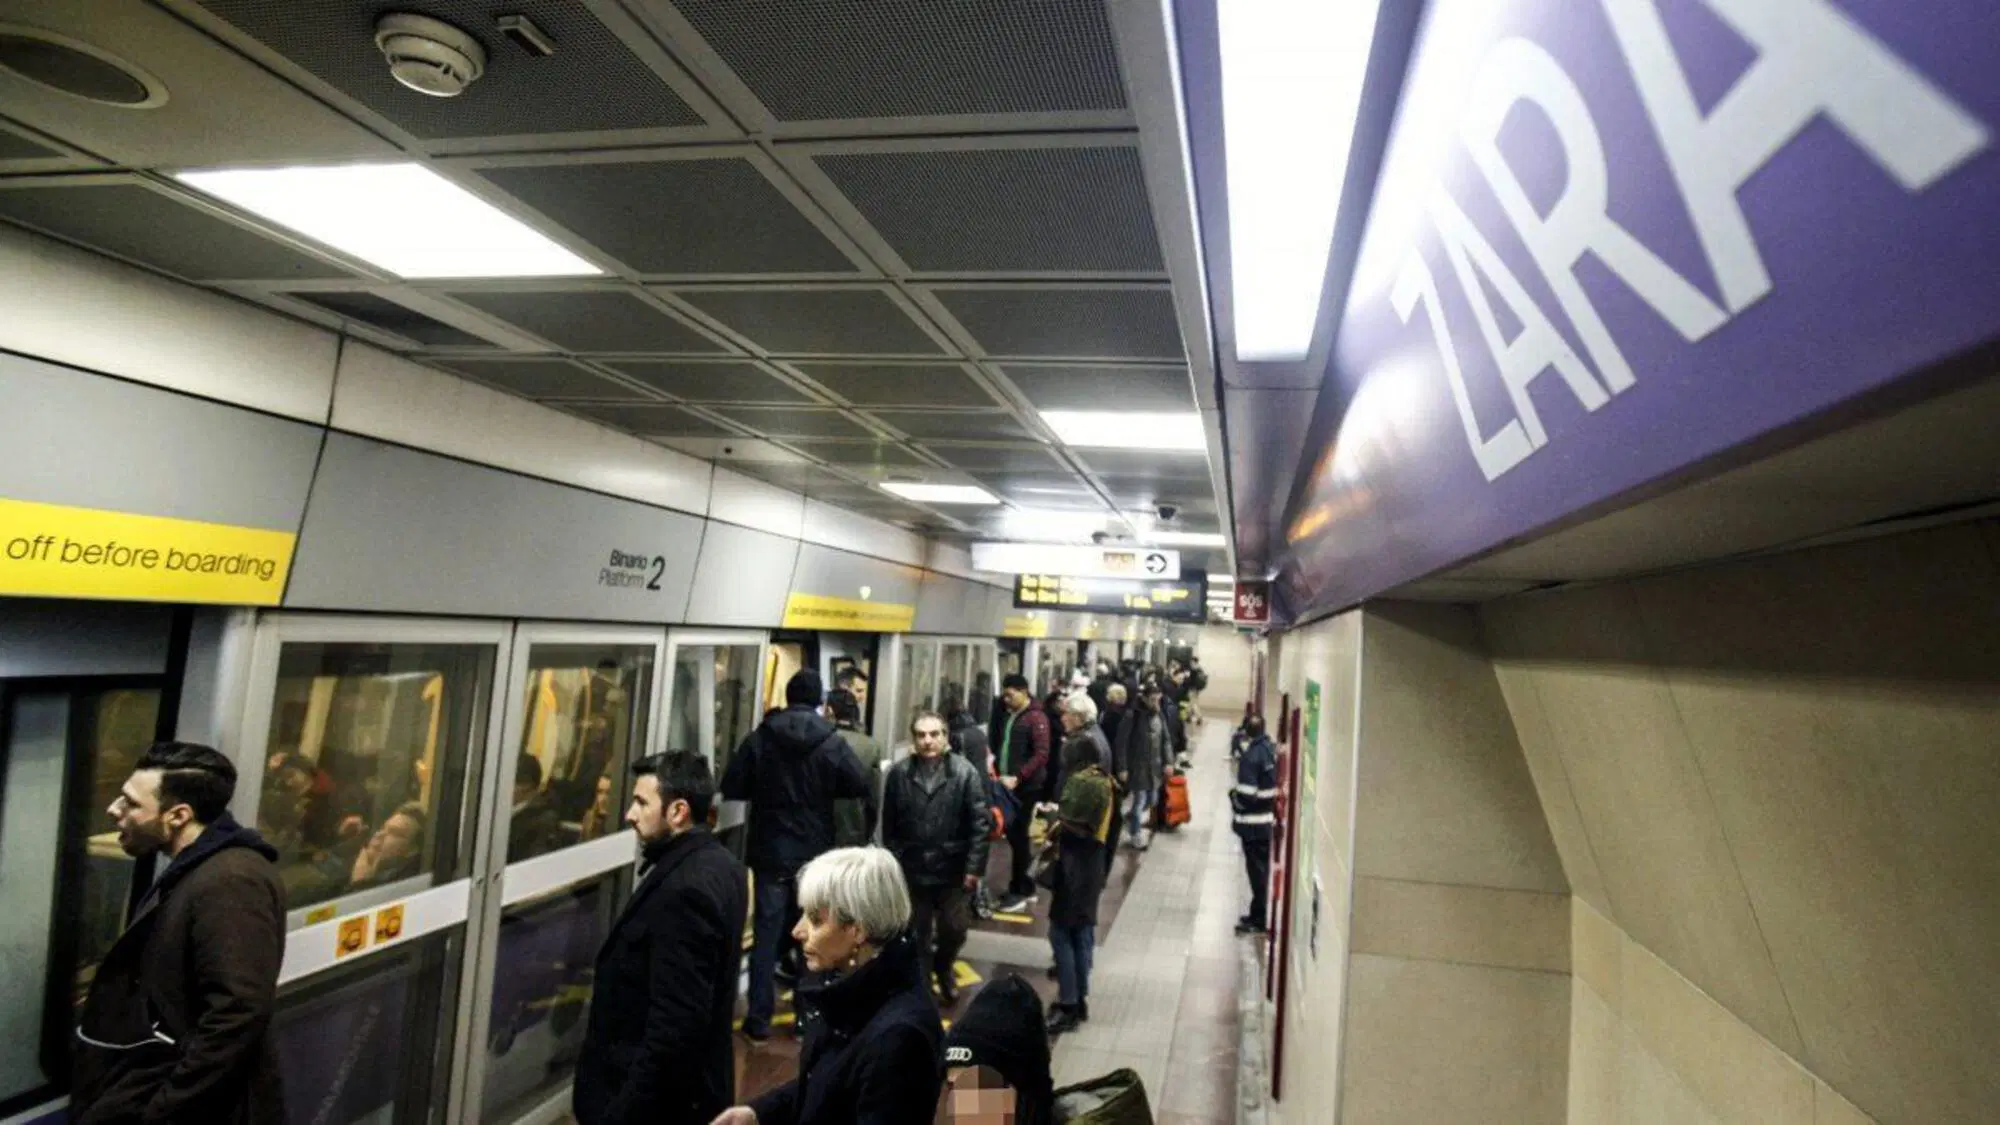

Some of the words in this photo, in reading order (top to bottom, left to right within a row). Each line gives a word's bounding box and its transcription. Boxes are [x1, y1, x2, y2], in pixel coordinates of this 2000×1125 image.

[1390, 0, 1992, 482] ZARA
[7, 535, 56, 561] off
[60, 538, 160, 570] before
[165, 547, 276, 582] boarding
[599, 567, 645, 588] Platform
[610, 550, 648, 570] Binario
[646, 555, 666, 591] 2
[1239, 593, 1263, 609] SOS
